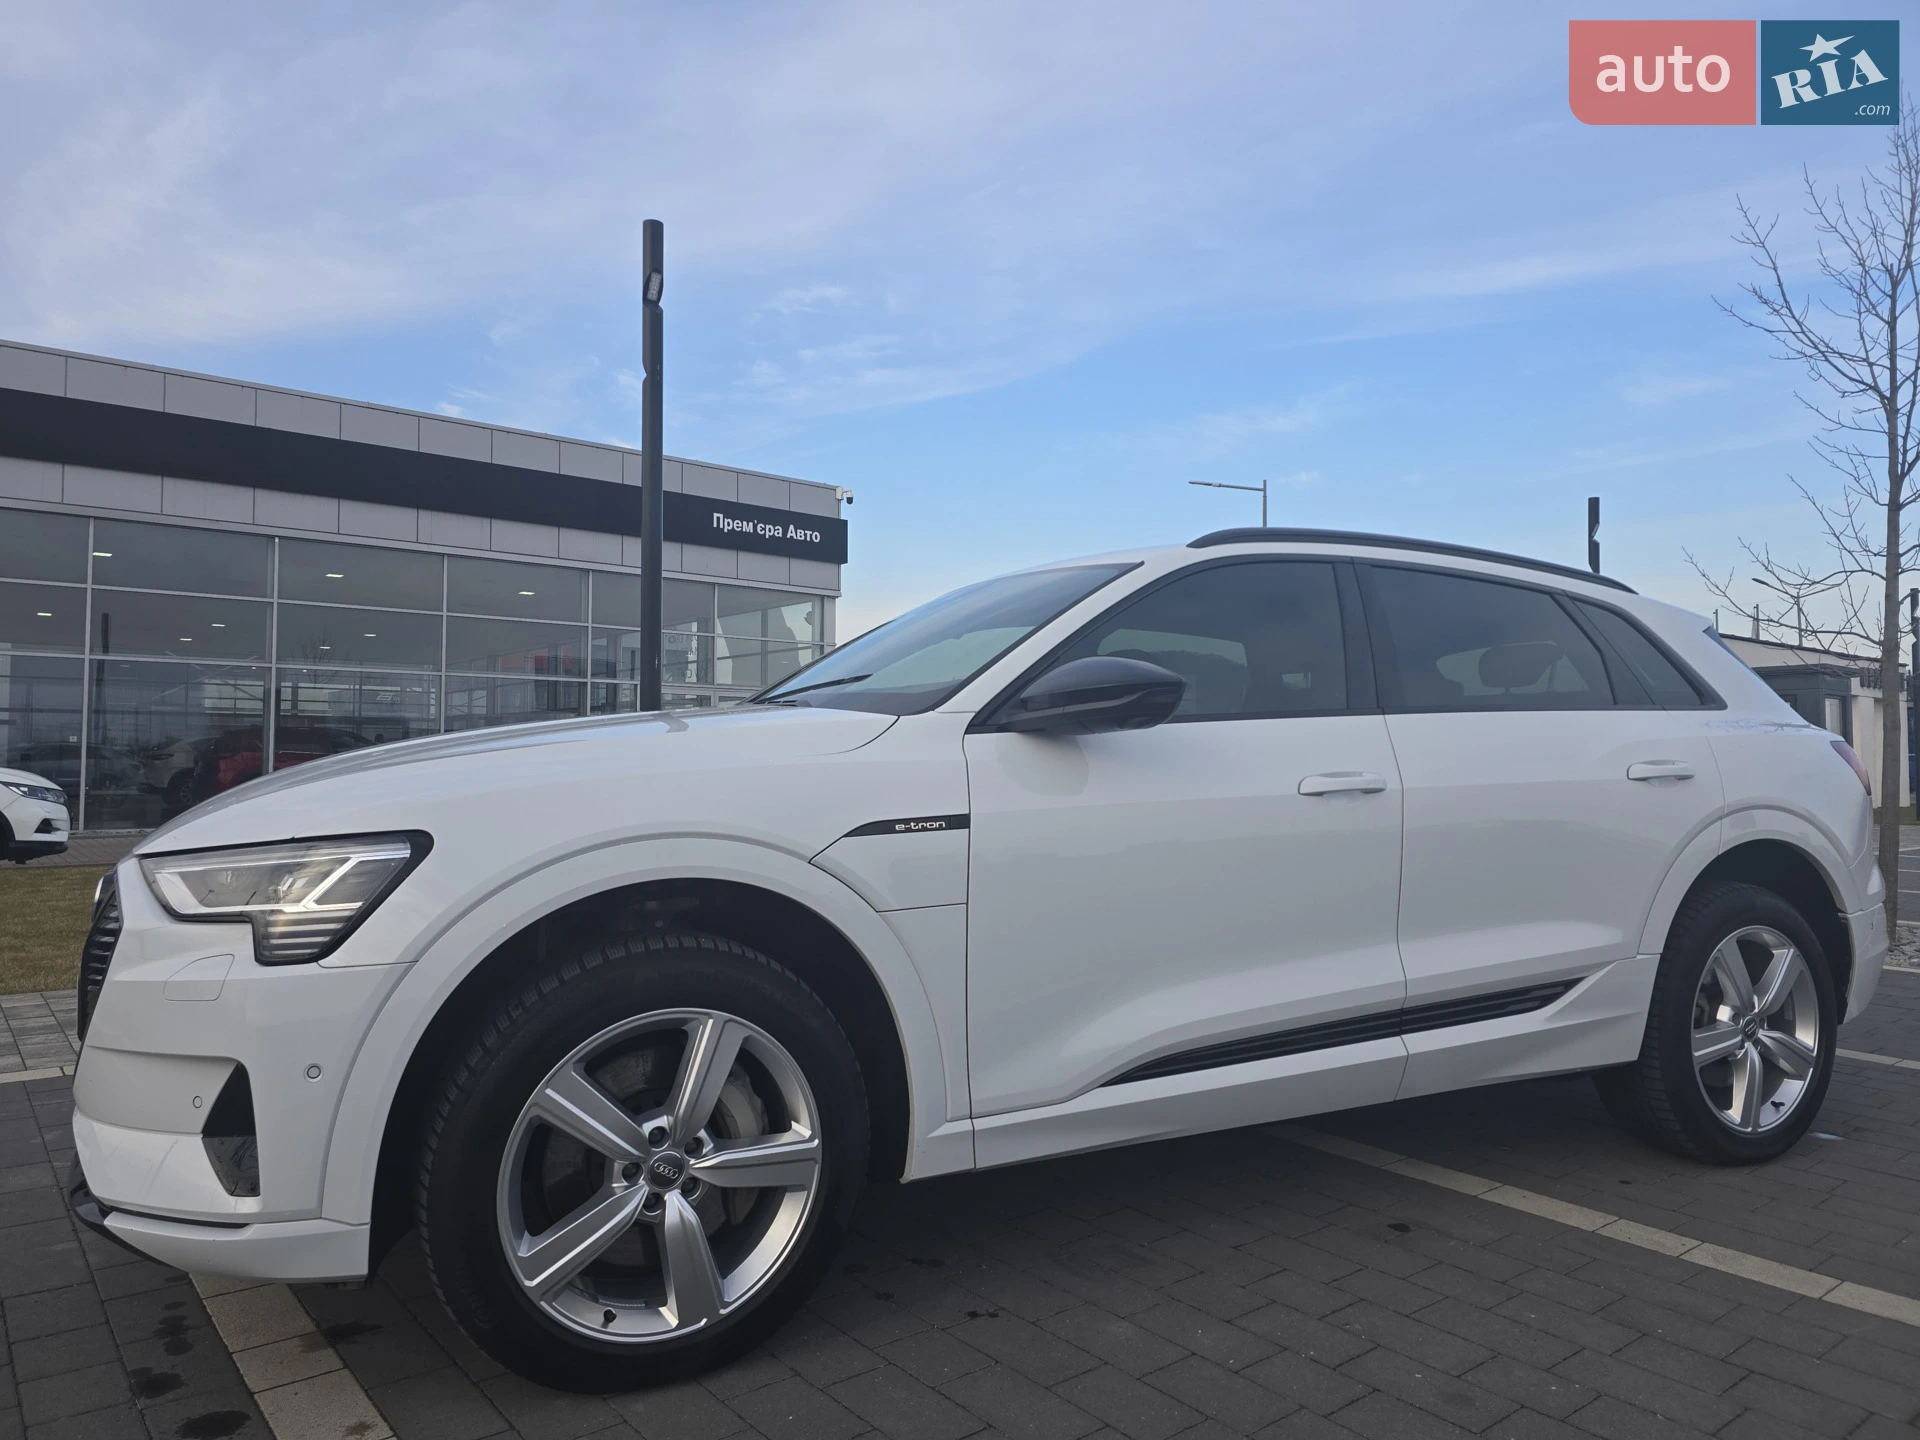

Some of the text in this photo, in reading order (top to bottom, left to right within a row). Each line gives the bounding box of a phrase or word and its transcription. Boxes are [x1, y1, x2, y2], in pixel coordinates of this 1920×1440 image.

[712, 512, 821, 543] Прем'єра Авто
[895, 821, 946, 831] e-tron
